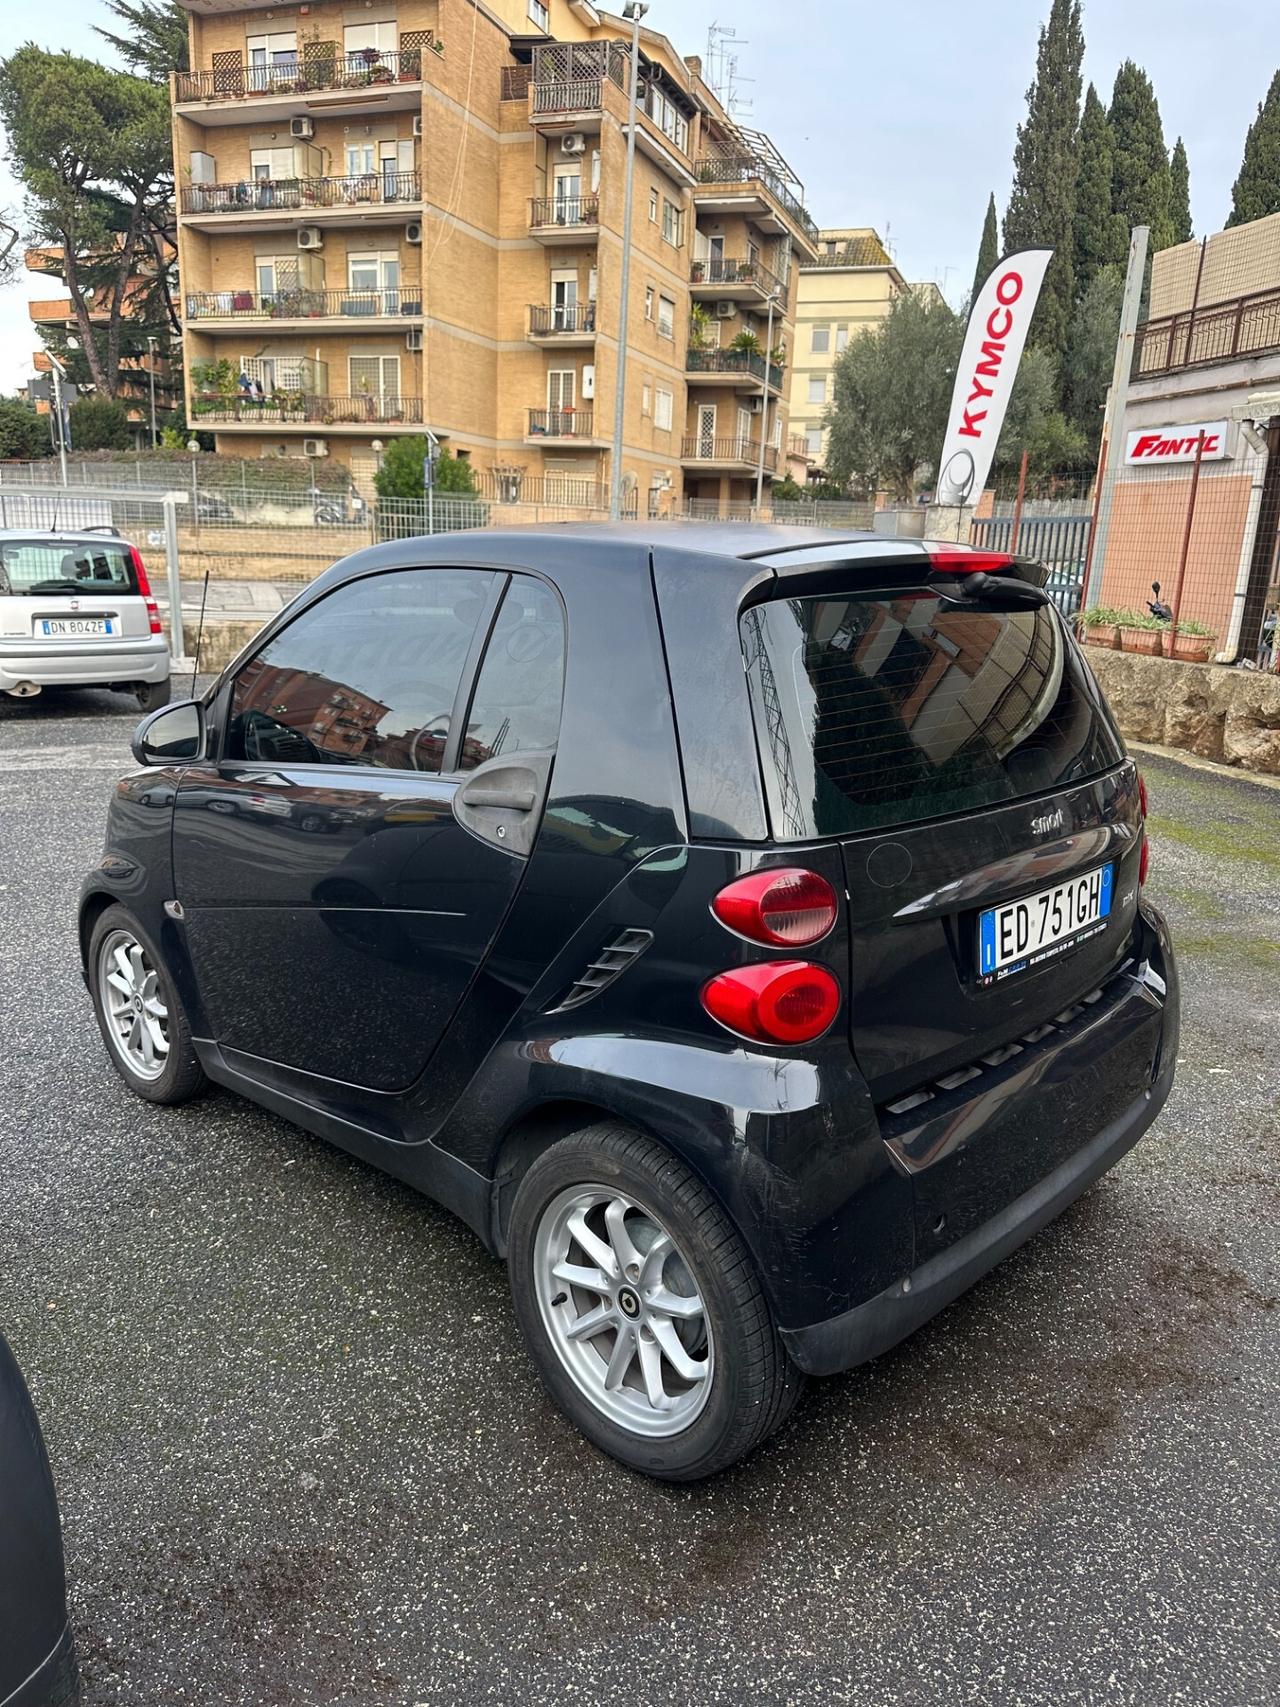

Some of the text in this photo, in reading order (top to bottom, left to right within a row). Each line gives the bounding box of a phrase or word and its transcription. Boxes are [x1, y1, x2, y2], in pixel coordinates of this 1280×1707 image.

[958, 271, 1023, 438] KYMCO
[51, 622, 66, 633] DN
[70, 621, 104, 632] 804ZF
[1031, 808, 1063, 835] smart
[1000, 903, 1029, 960] ED
[1038, 873, 1100, 944] 751GH
